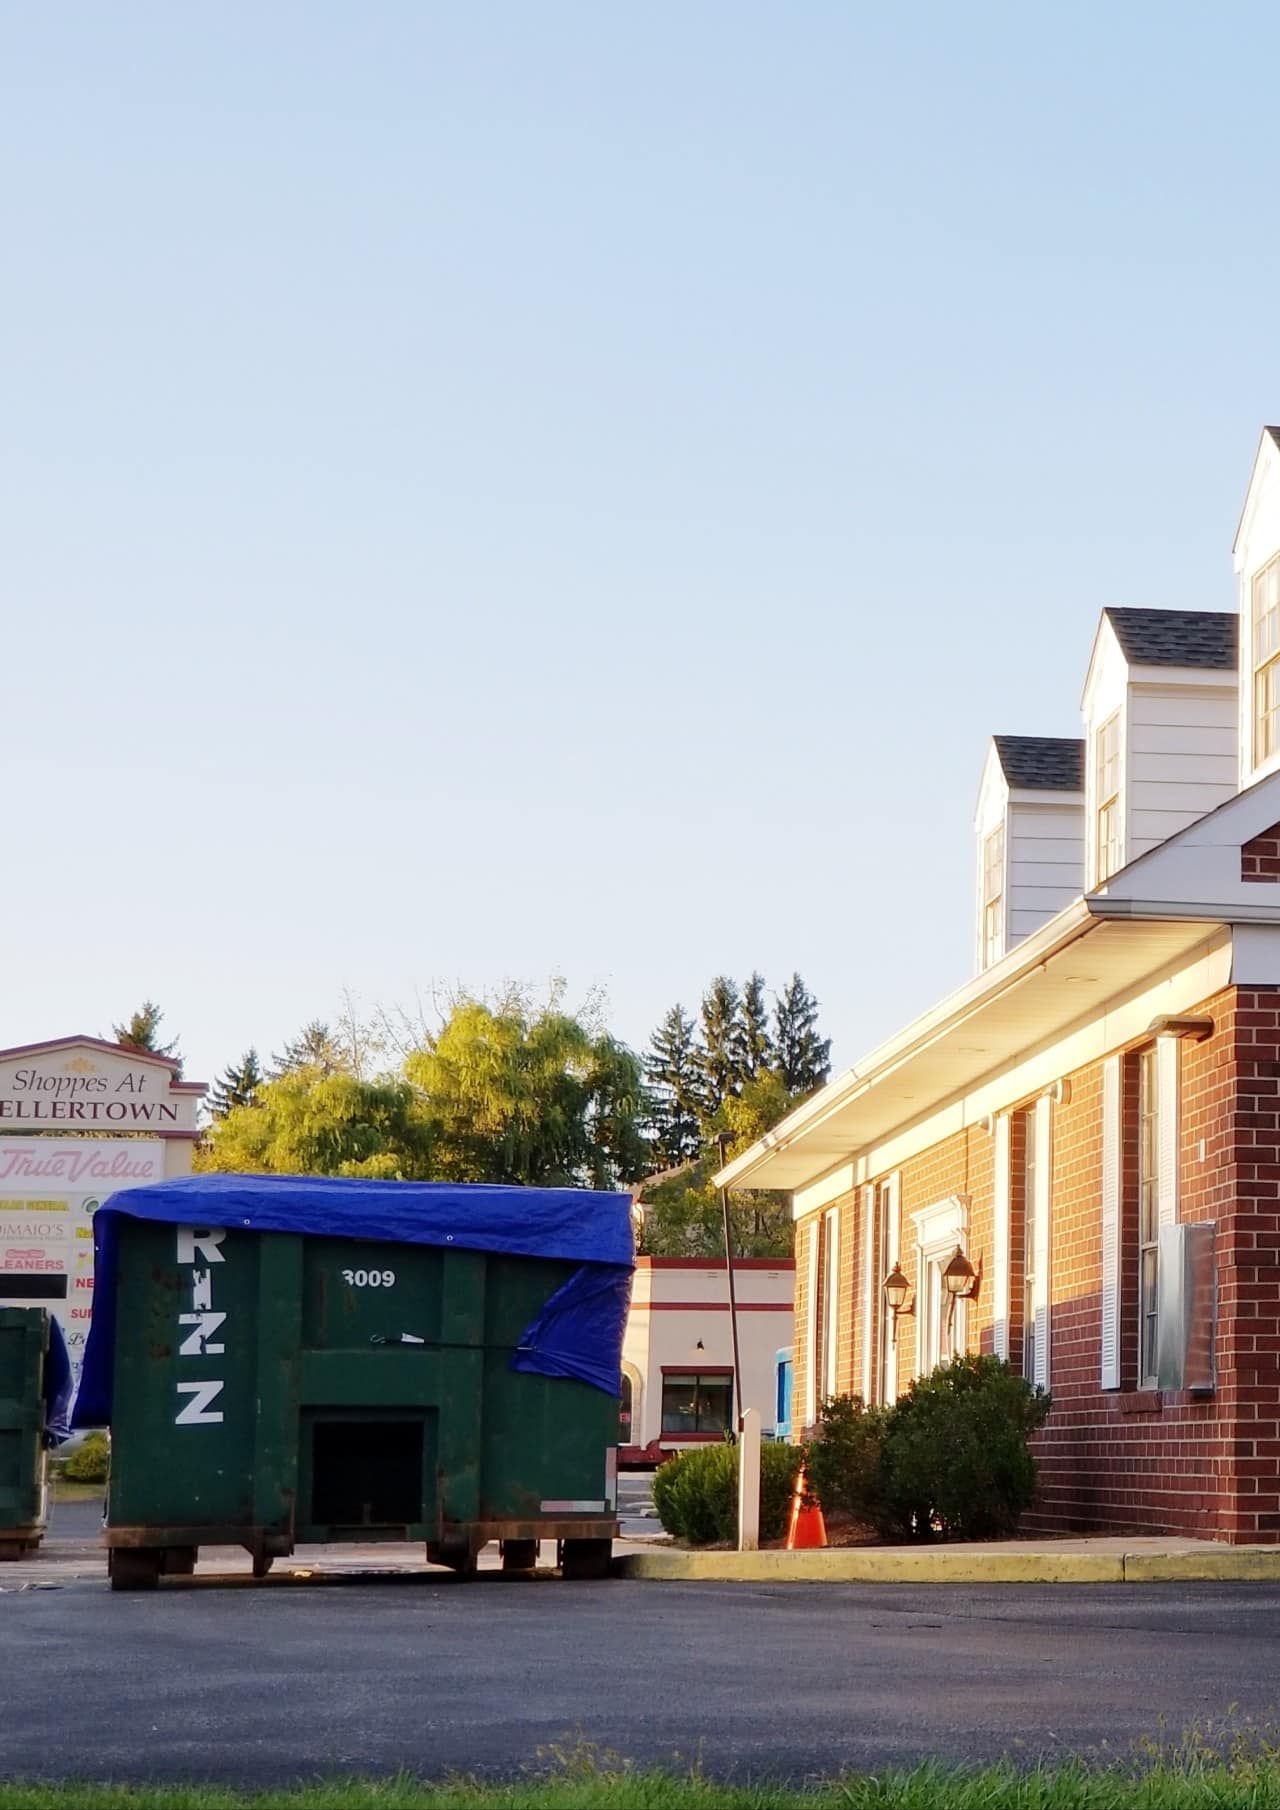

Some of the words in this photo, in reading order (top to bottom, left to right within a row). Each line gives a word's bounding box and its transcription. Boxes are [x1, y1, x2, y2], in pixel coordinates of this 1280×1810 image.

[12, 1069, 108, 1099] Shoppes
[115, 1072, 147, 1093] At
[341, 1269, 396, 1288] 3009
